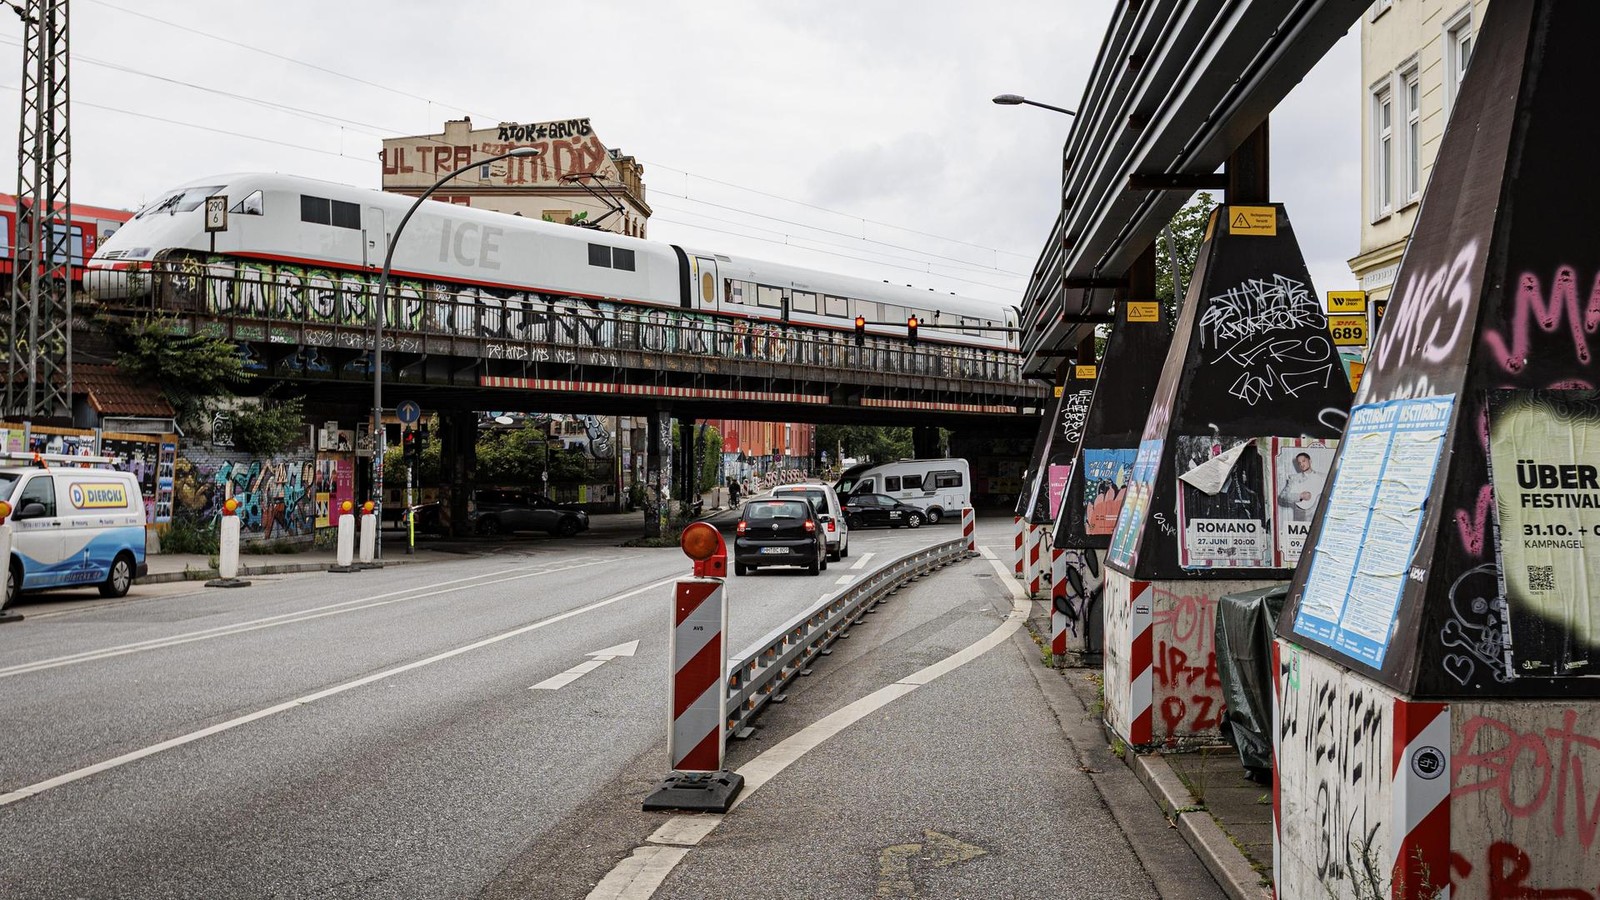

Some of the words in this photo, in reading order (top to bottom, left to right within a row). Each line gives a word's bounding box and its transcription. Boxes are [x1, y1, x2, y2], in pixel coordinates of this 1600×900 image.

[383, 145, 472, 177] ULTRA
[209, 201, 223, 212] 290
[213, 213, 219, 223] 6
[439, 218, 505, 271] ICE
[1332, 327, 1363, 340] 689
[1516, 459, 1600, 489] ÜBER
[87, 489, 123, 503] DIERCKS
[1520, 493, 1600, 508] FESTIVAL
[1196, 522, 1257, 533] ROMANO
[1288, 525, 1311, 535] MA
[1523, 524, 1573, 536] 31.10.
[1233, 538, 1256, 546] 20:00
[1524, 540, 1585, 549] KAMPNAGEL
